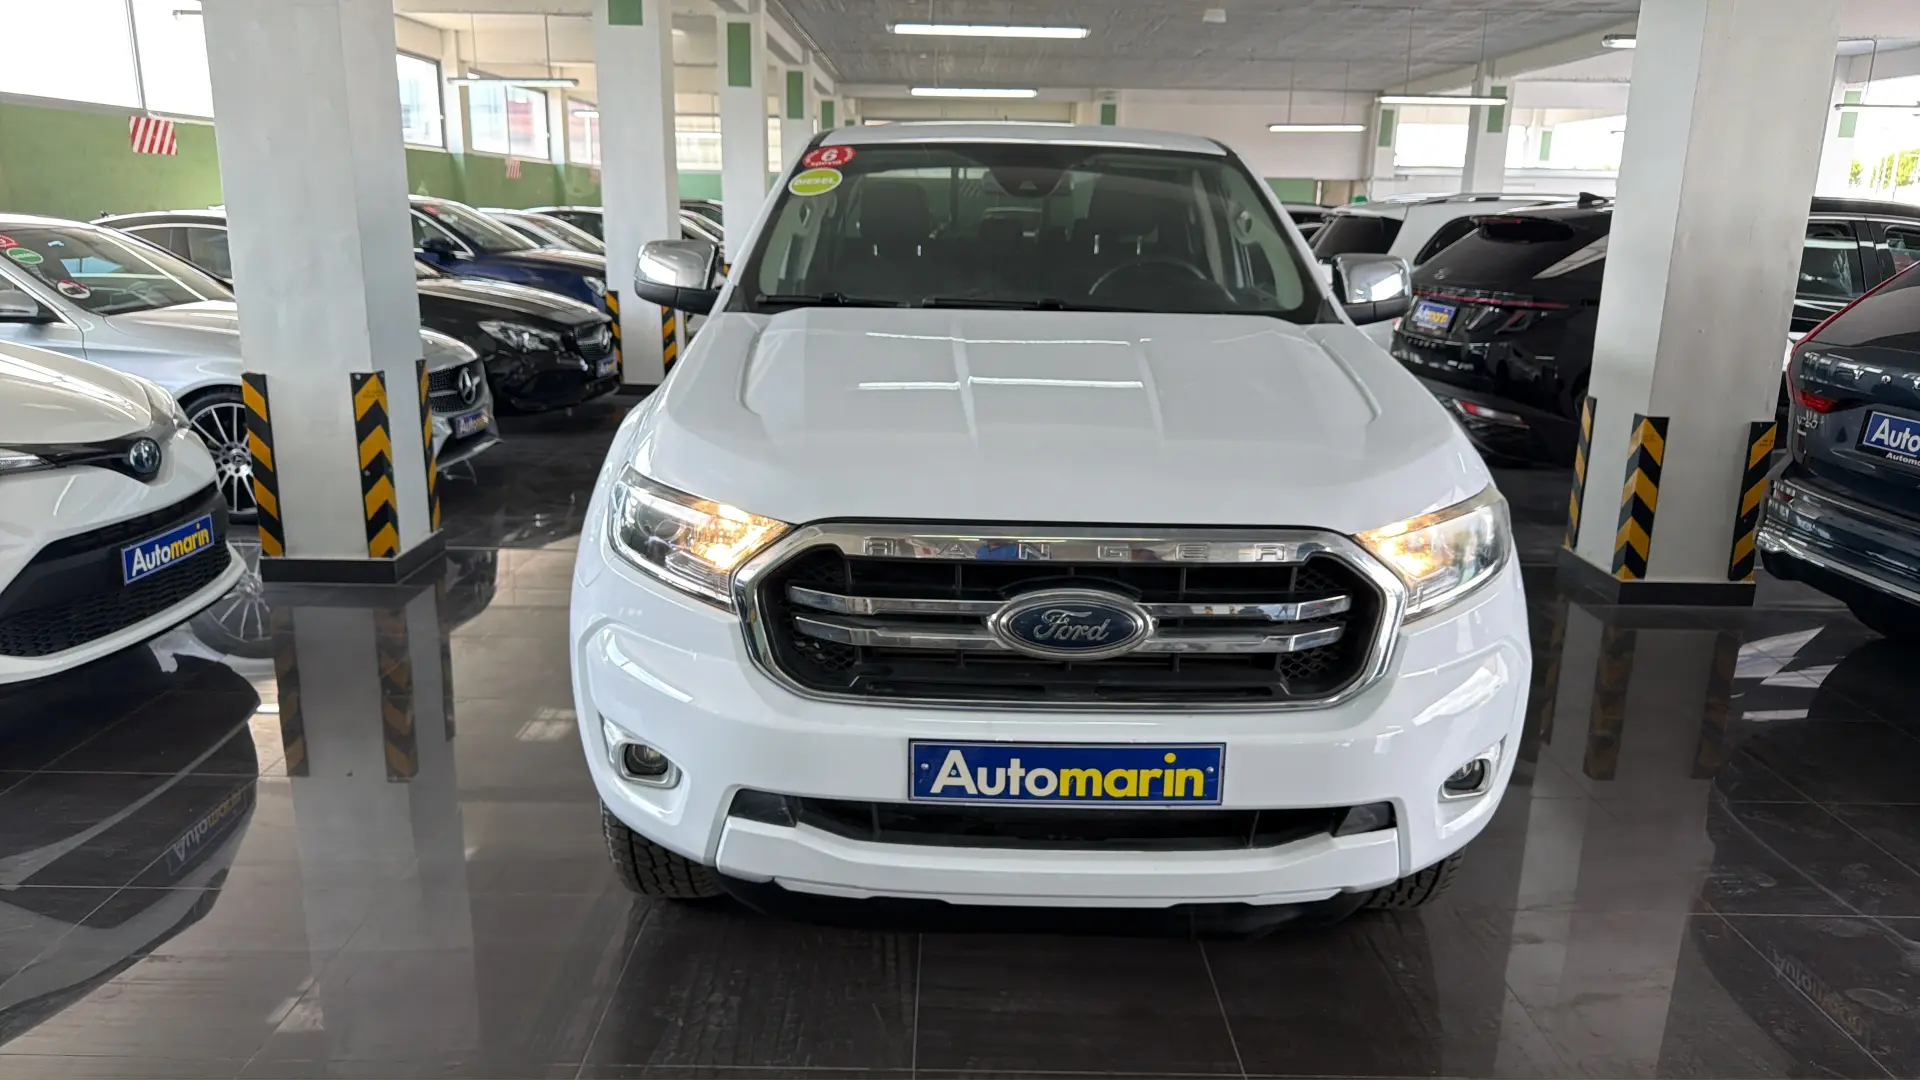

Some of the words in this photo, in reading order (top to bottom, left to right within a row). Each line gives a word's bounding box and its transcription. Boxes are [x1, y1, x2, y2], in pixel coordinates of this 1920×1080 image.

[820, 148, 839, 162] 6
[794, 176, 834, 186] DIESEL
[132, 522, 210, 577] Automarin
[863, 536, 1286, 562] RANGER
[1033, 608, 1111, 641] Ford
[929, 749, 1205, 798] Automarin
